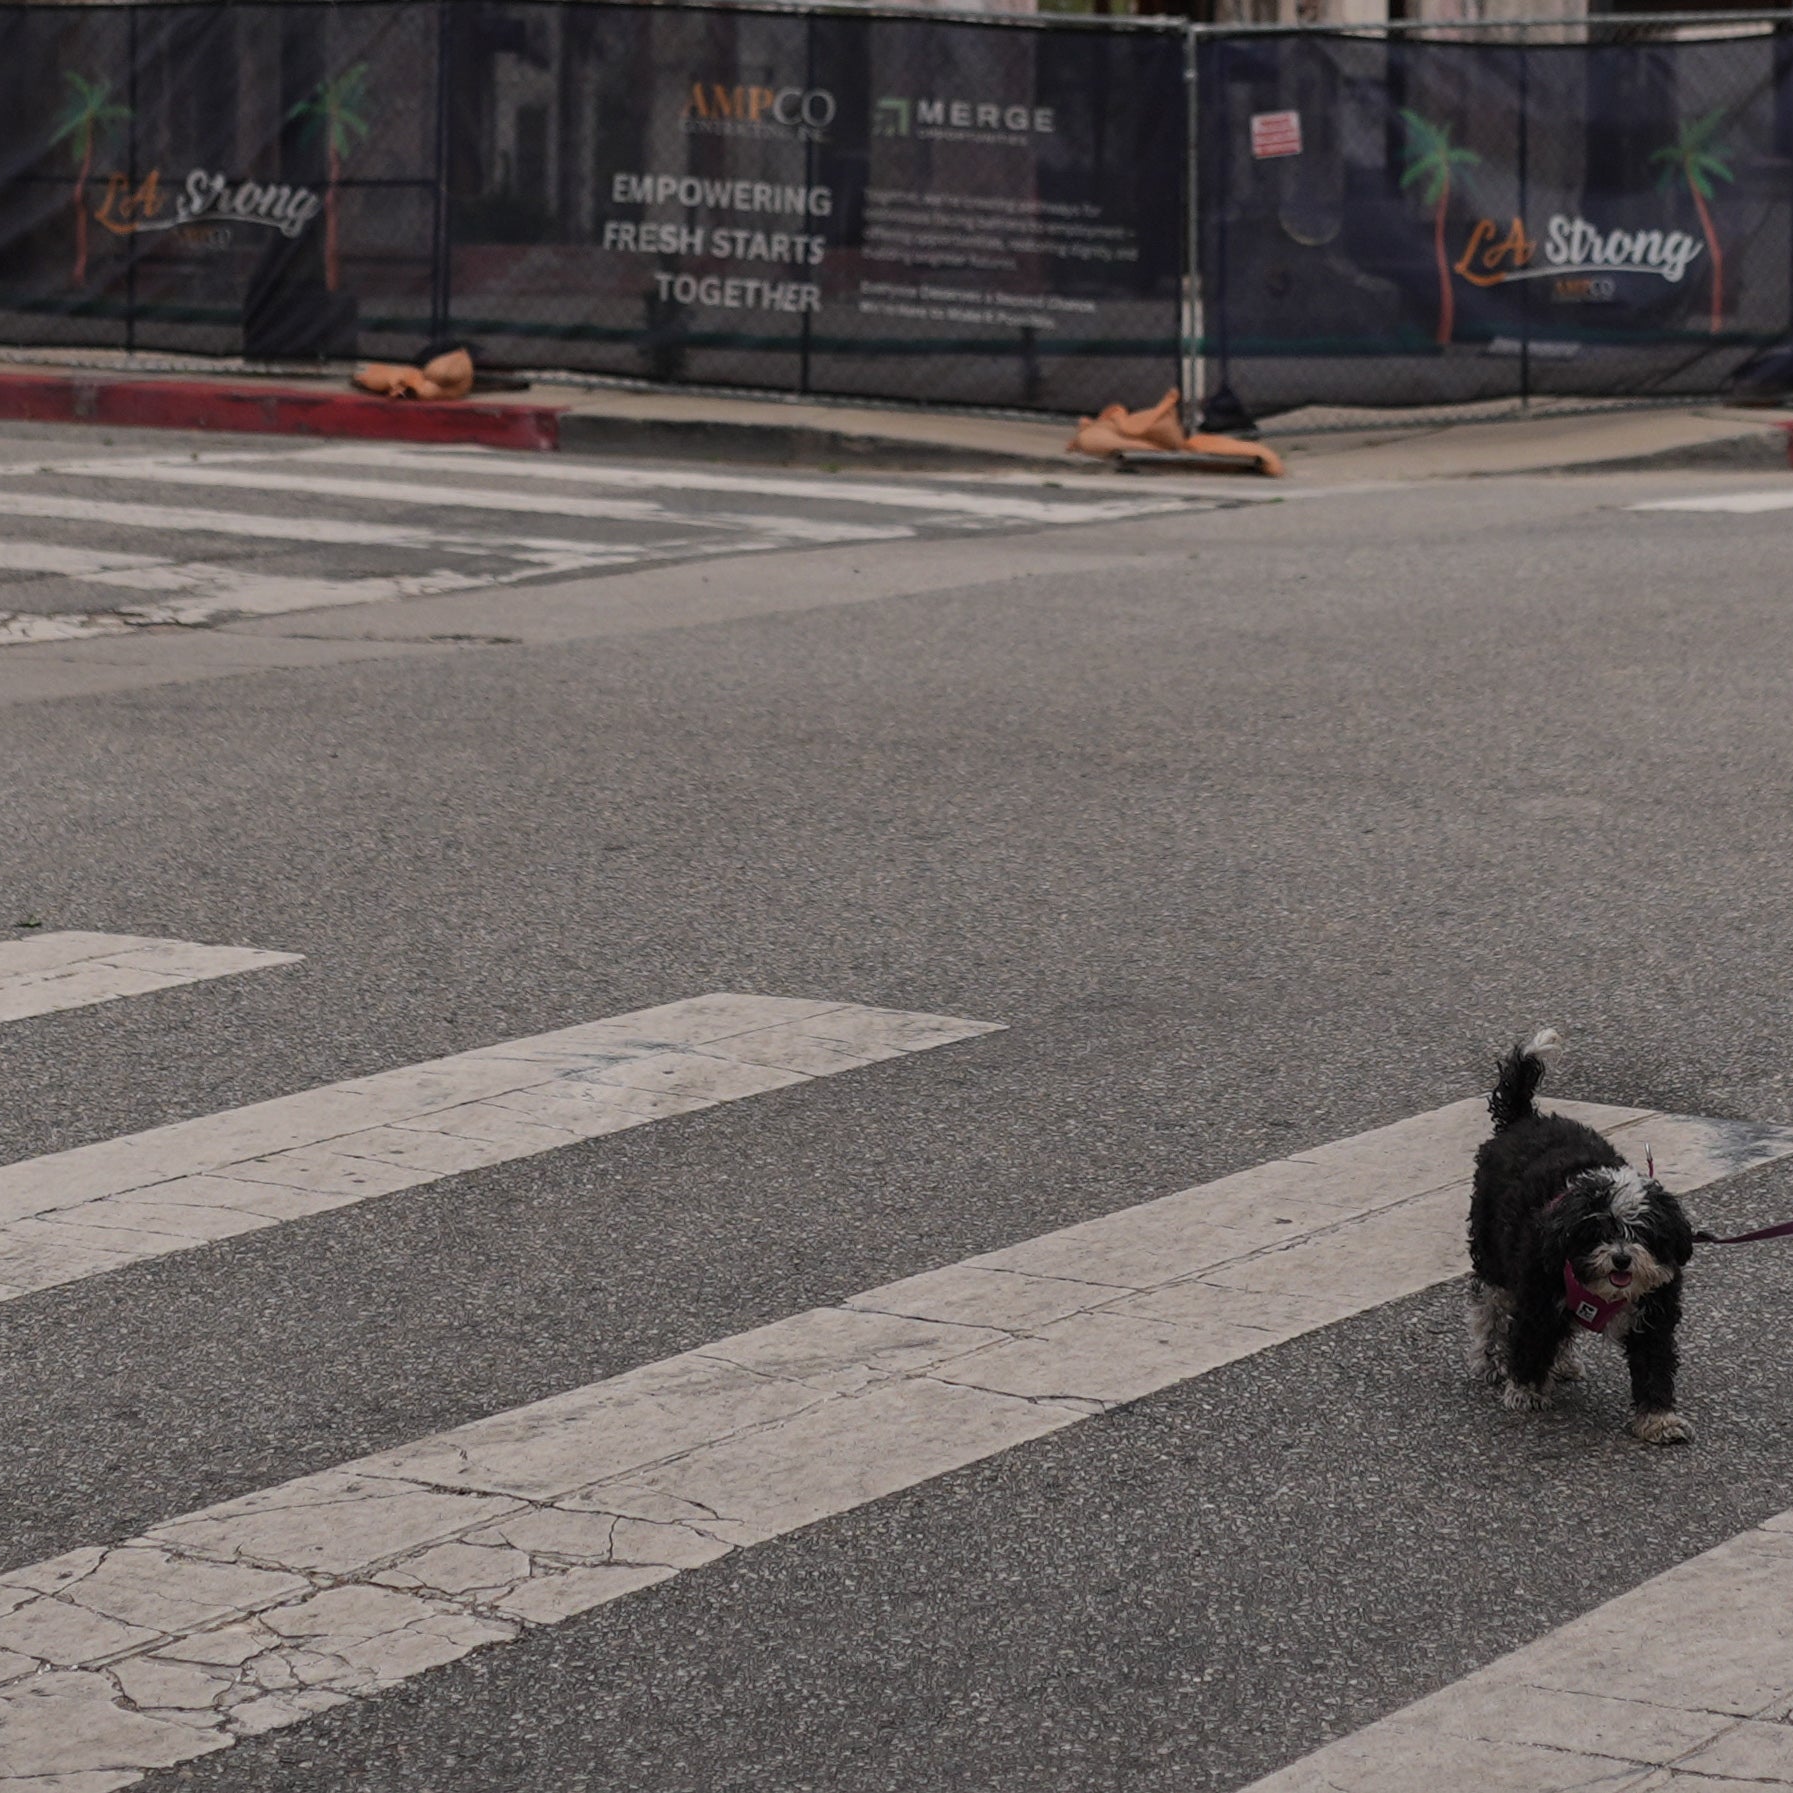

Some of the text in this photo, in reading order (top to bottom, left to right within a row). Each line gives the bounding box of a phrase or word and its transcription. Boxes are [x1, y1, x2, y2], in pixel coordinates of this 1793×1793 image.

[683, 81, 1057, 133] AMPCO MERGE
[94, 167, 322, 238] LA Strong
[611, 172, 833, 218] EMPOWERING
[602, 220, 706, 256] FRESH
[710, 226, 827, 265] STARTS
[1453, 213, 1705, 287] LA Strong
[653, 269, 825, 313] TOGETHER
